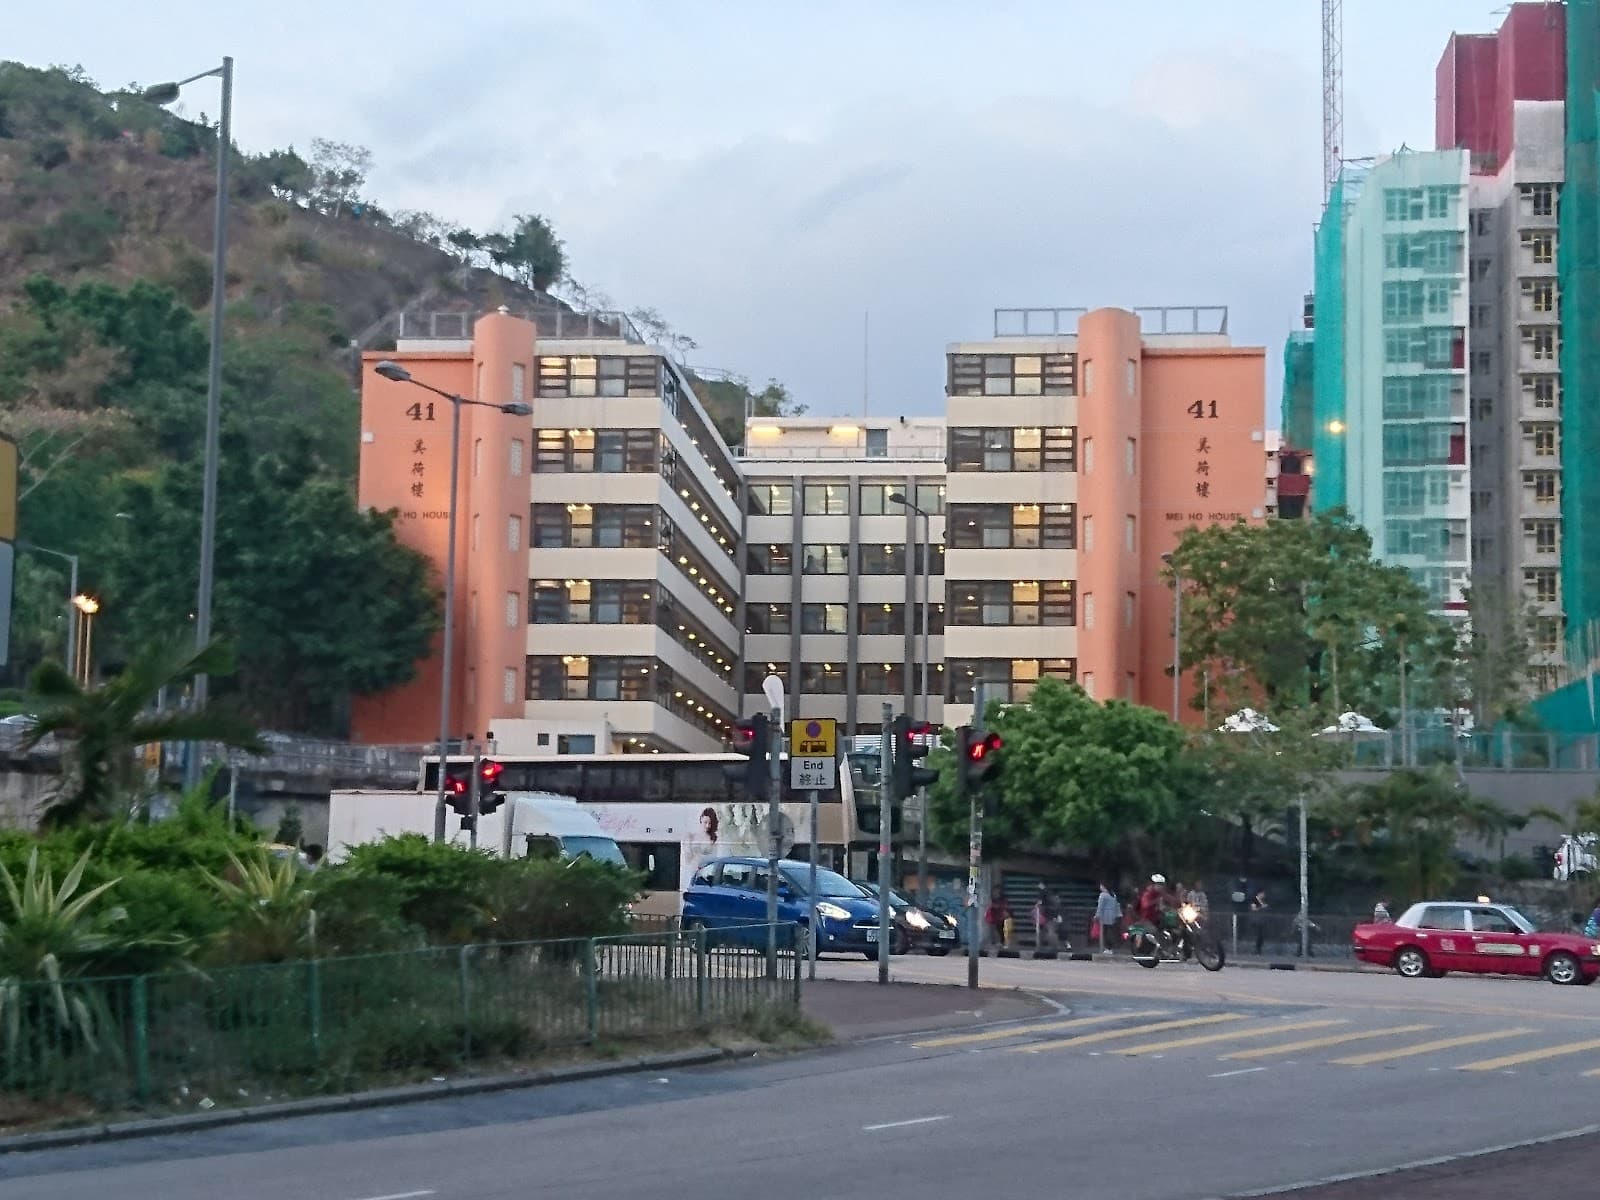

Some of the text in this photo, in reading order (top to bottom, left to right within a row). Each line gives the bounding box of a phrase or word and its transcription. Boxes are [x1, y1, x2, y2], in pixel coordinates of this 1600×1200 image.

[406, 402, 436, 421] 41
[1187, 400, 1219, 419] 41
[411, 438, 427, 498] 美荷樓
[1196, 437, 1211, 499] 美荷樓
[403, 511, 450, 520] HO HOUS
[1165, 512, 1183, 521] MEI
[1188, 512, 1203, 521] HO
[803, 760, 824, 770] End
